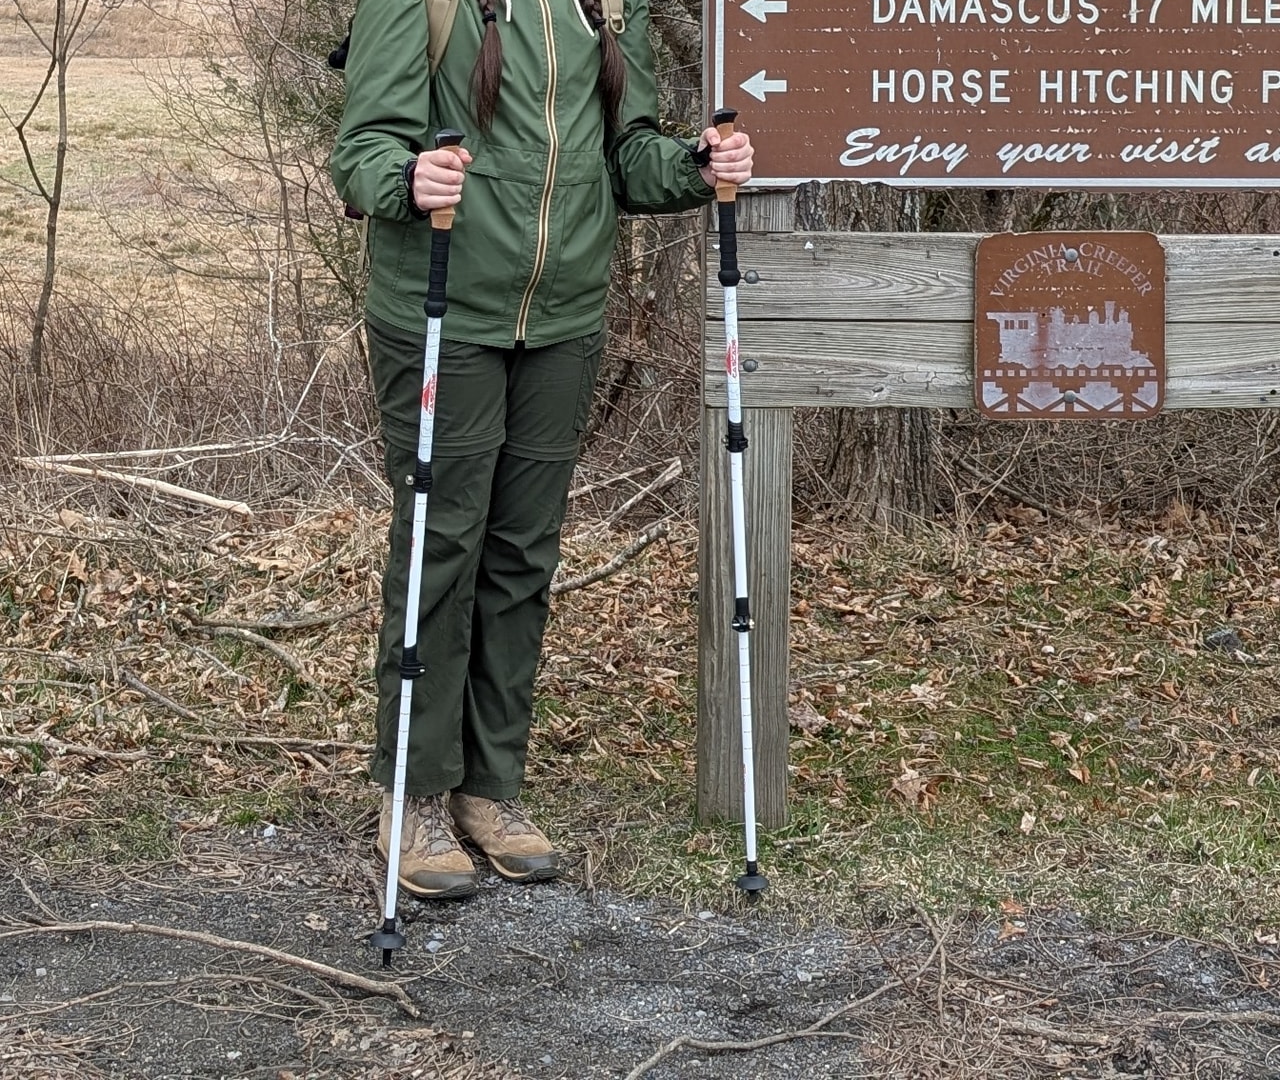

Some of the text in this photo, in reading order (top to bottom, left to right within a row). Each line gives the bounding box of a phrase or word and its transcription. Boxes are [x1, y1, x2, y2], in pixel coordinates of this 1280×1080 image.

[872, 69, 1011, 104] HORSE
[1039, 69, 1235, 104] HITCHING
[838, 127, 970, 176] Enjoy
[995, 142, 1093, 174] your
[1119, 135, 1221, 165] visit
[990, 242, 1153, 297] VIRGINIA CREEPER
[1041, 257, 1104, 278] TRAIL
